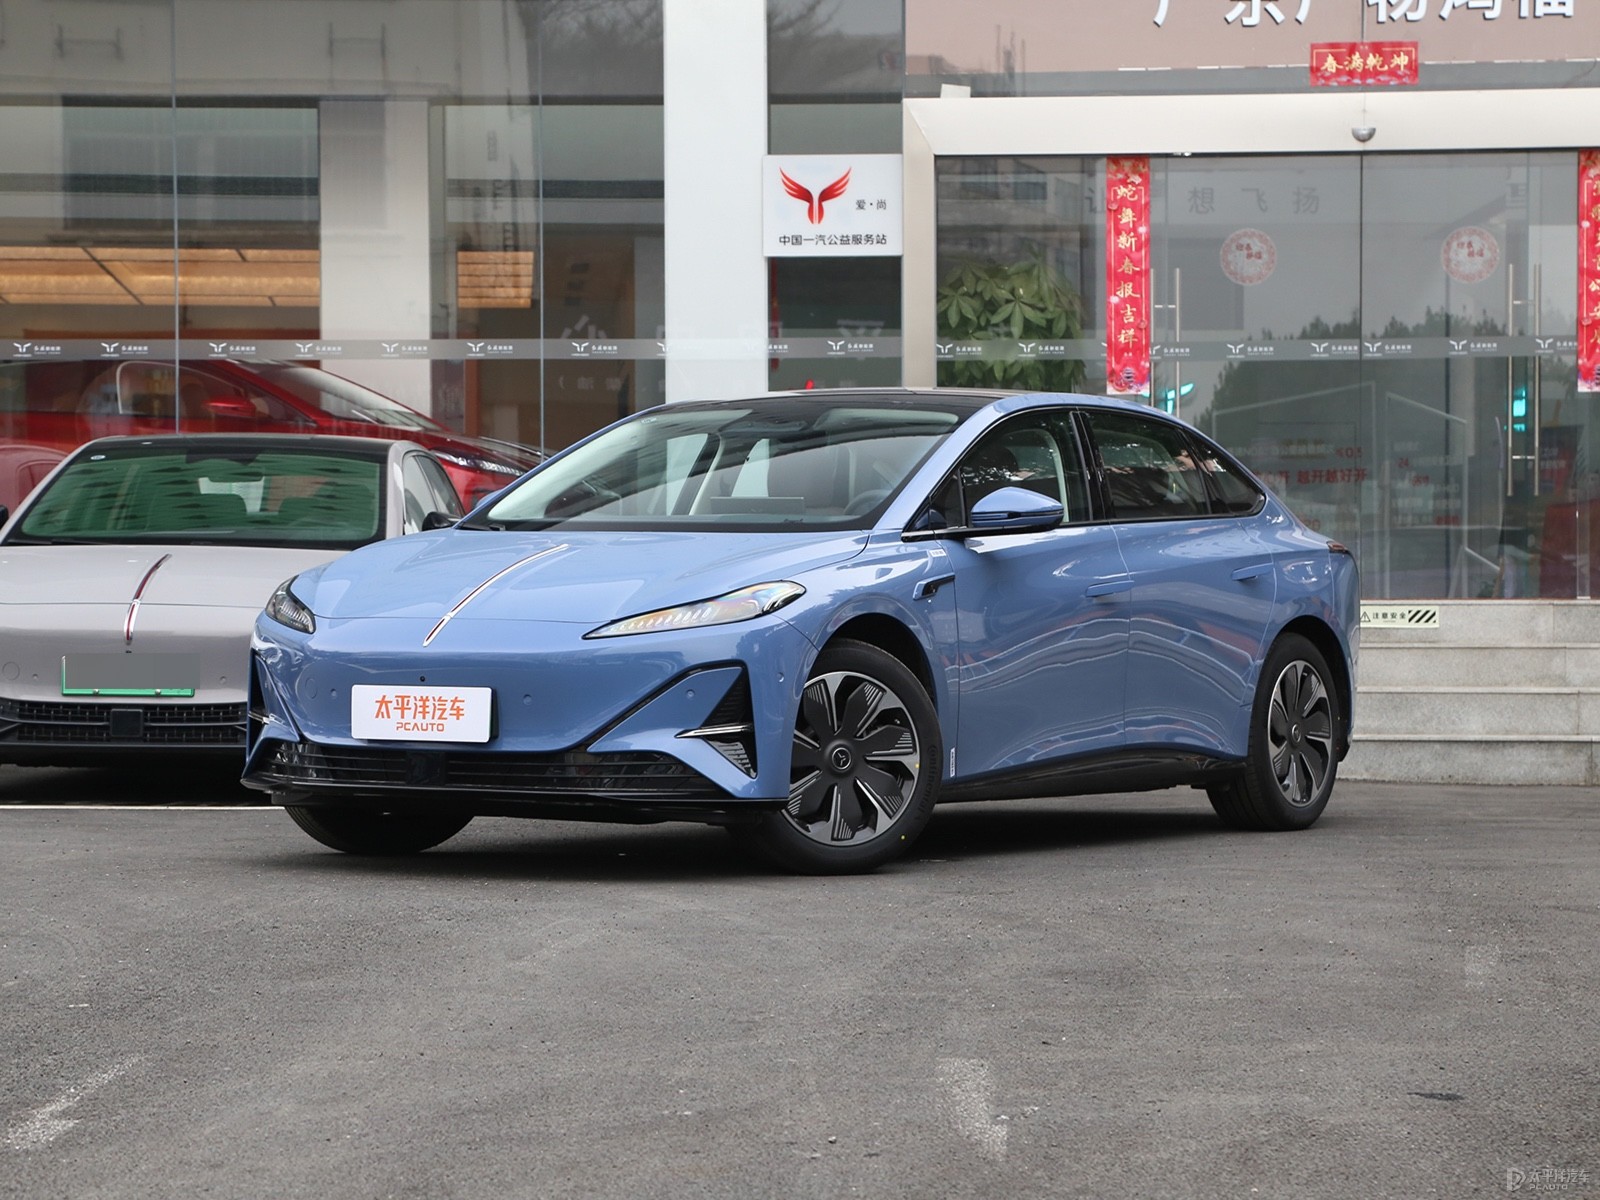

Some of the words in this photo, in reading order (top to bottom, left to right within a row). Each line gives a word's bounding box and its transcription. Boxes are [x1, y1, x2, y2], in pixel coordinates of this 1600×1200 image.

[1320, 51, 1409, 73] 春满乾坤
[855, 199, 887, 210] 爱·尚
[779, 234, 887, 246] 中国一汽公益服务站
[1116, 184, 1141, 348] 蛇舞新春报吉祥
[374, 694, 465, 721] 太平洋汽车
[396, 722, 445, 732] PCAUTO
